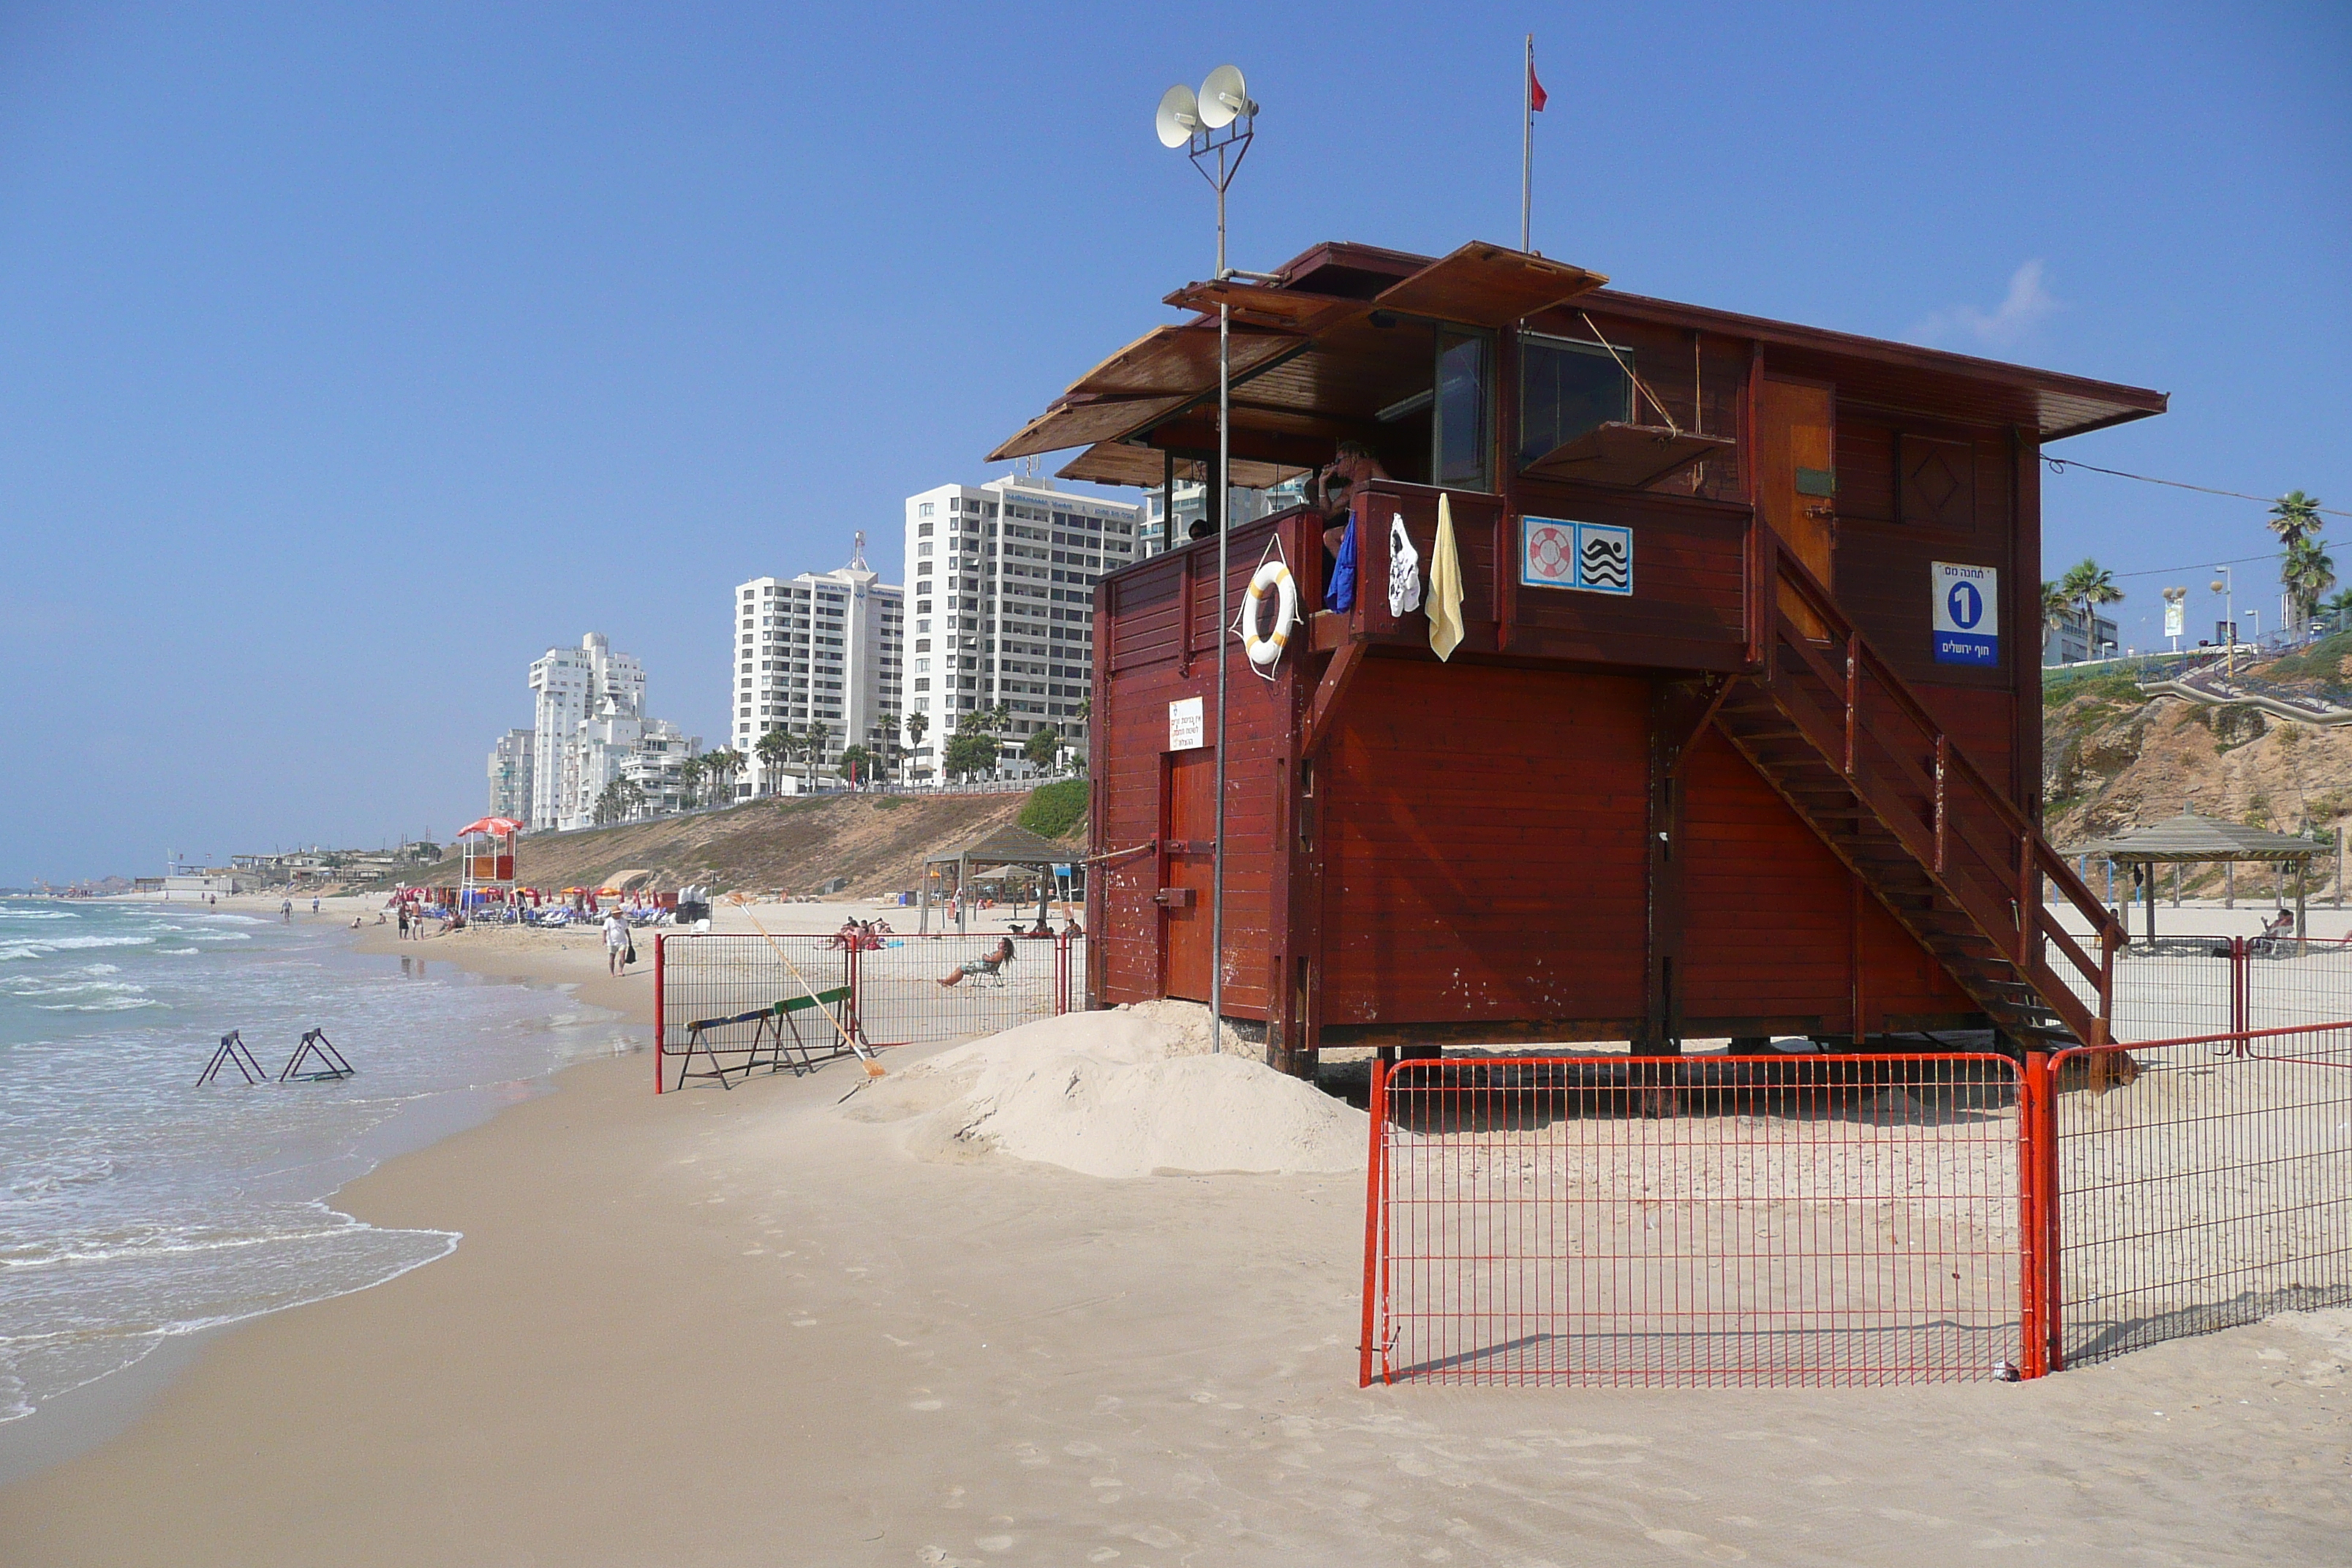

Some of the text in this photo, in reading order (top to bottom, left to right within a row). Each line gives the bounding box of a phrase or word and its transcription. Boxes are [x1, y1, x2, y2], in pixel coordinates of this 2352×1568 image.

[1960, 568, 1984, 578] תחנה
[1954, 587, 1970, 623] 1
[1942, 640, 1989, 658] חוף ירושלים
